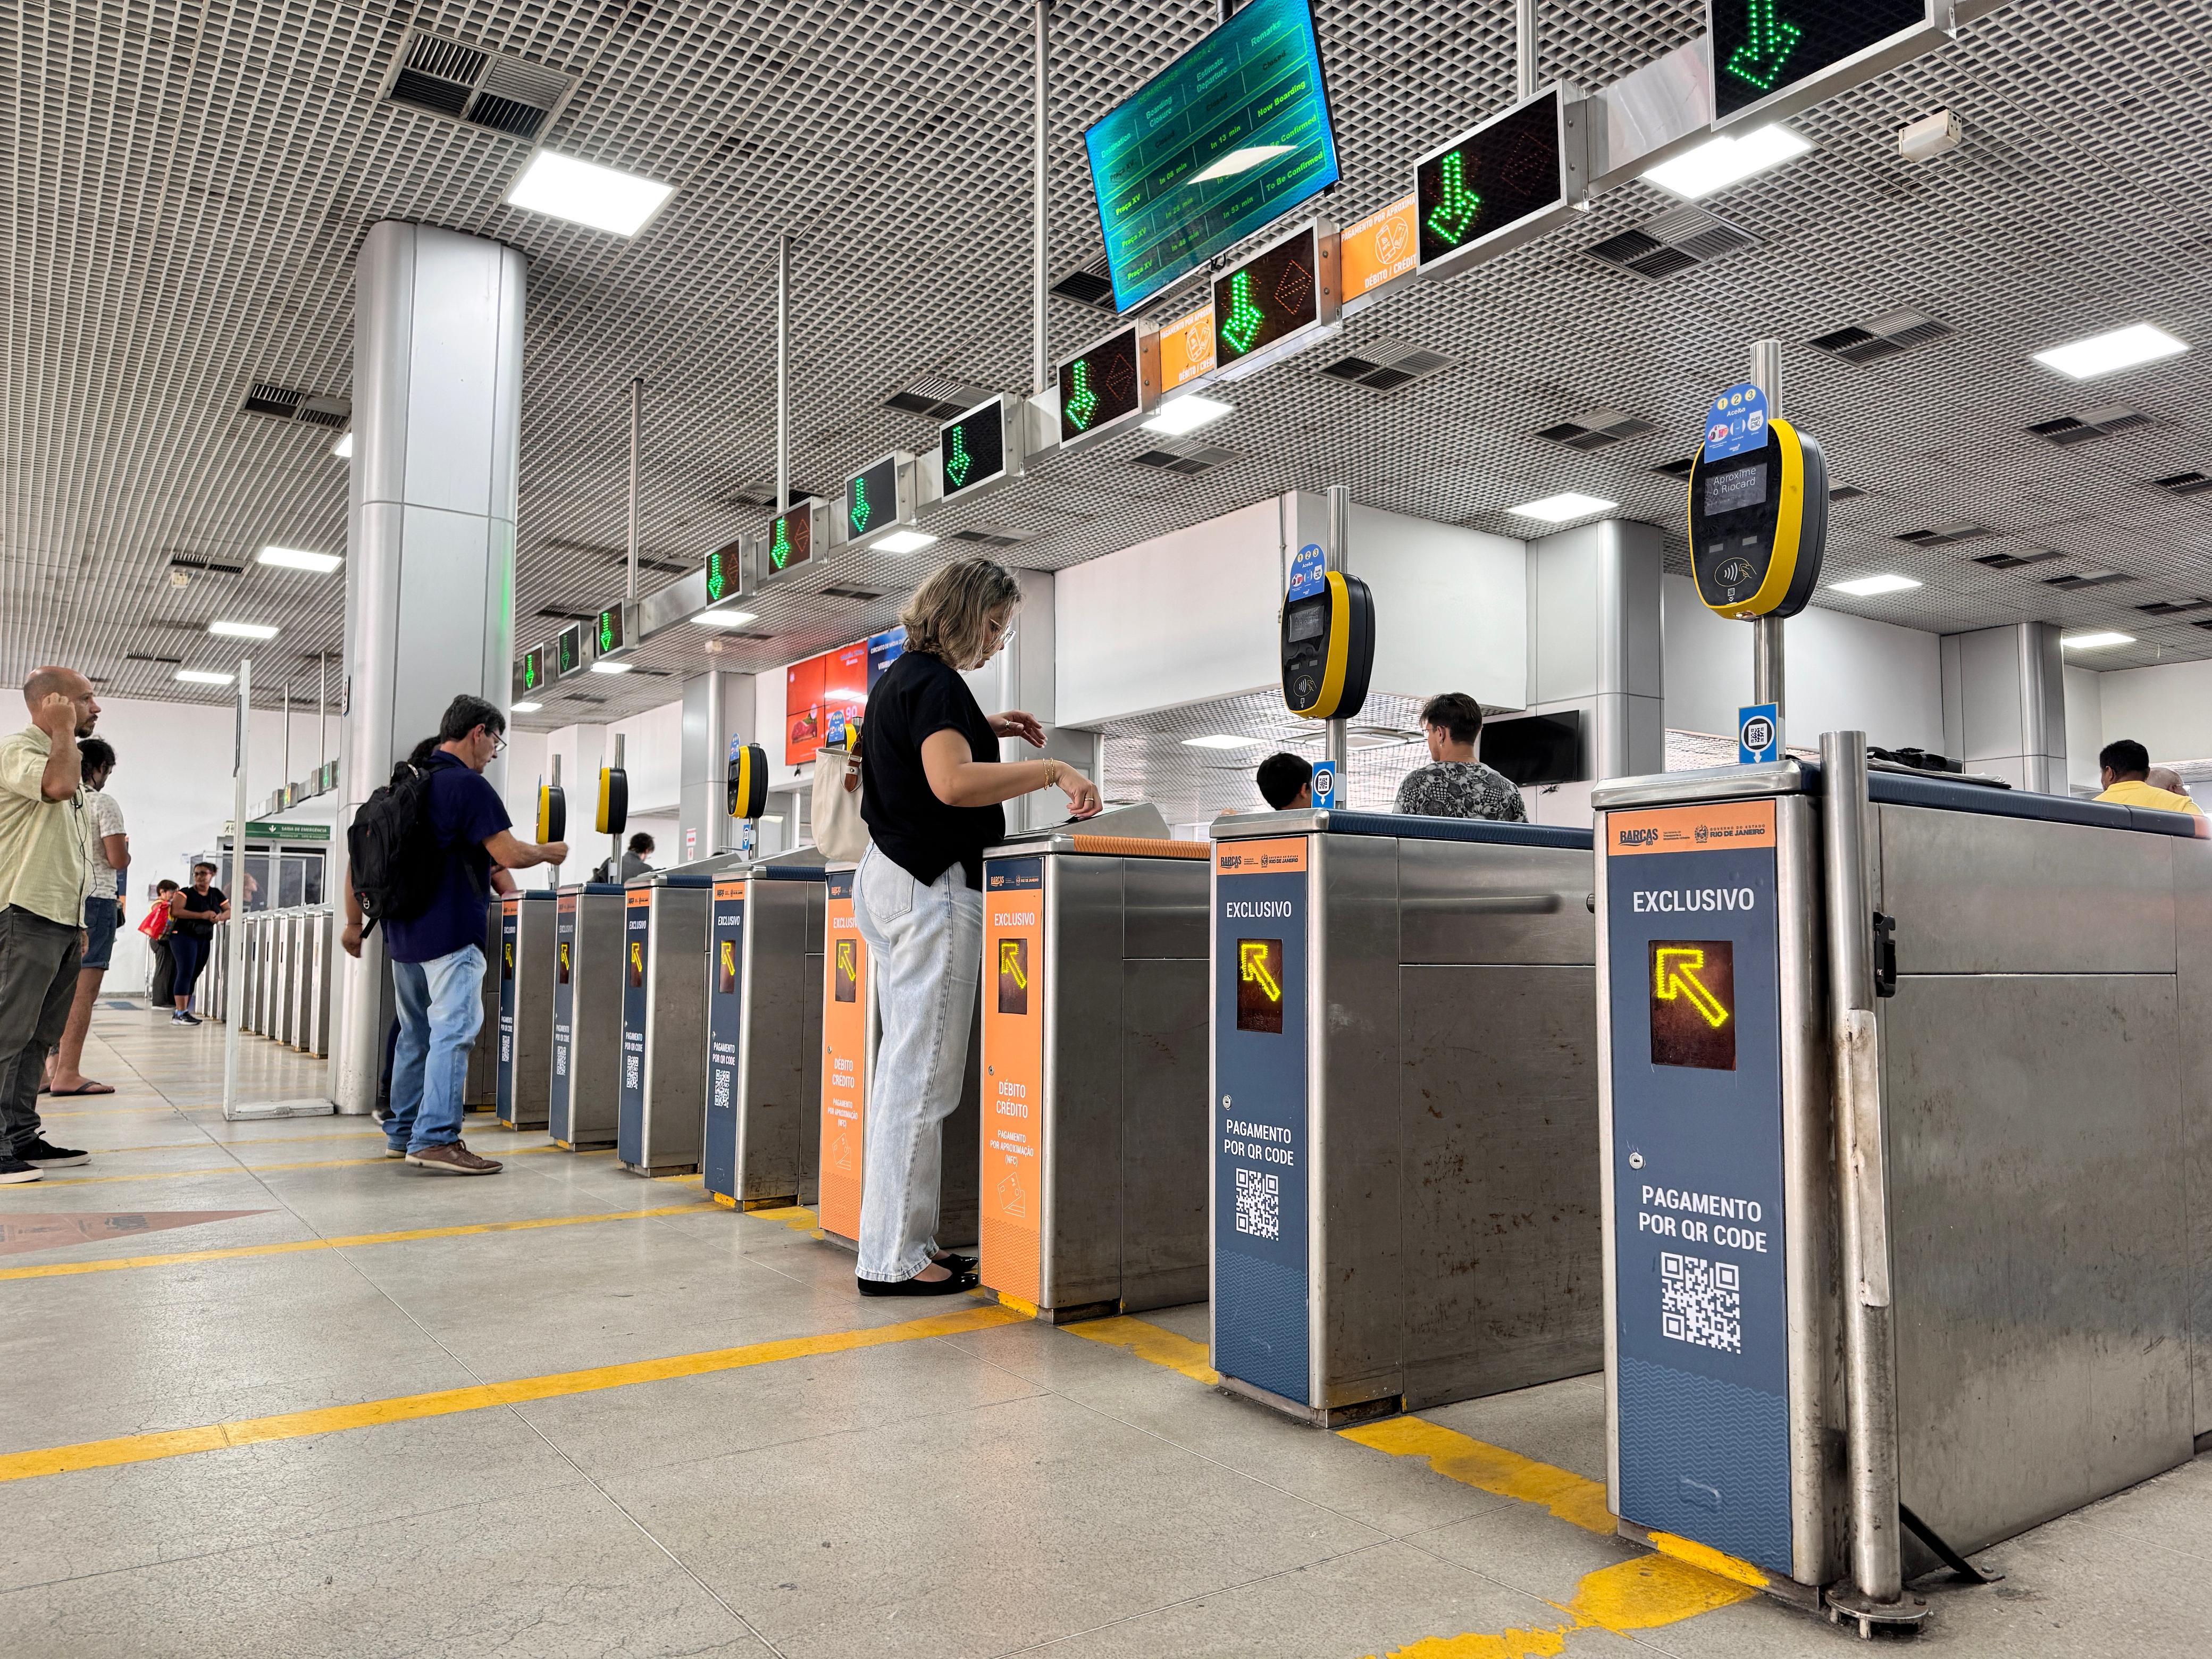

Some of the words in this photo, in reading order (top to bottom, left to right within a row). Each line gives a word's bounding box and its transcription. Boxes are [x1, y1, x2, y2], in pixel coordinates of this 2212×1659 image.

[1251, 20, 1281, 47] Remarks
[1197, 57, 1224, 81] Estimate
[1262, 50, 1286, 71] Closed
[1197, 66, 1227, 93] Departure
[1146, 96, 1172, 119] Boarding
[1205, 92, 1228, 112] Closed
[1256, 101, 1273, 118] Now
[1274, 80, 1306, 106] Boarding
[1150, 107, 1172, 128] Closure
[1218, 135, 1227, 143] 13
[1229, 125, 1241, 137] min
[1281, 114, 1317, 143] Confirmed
[1101, 133, 1132, 158] Destination
[1176, 162, 1187, 173] min
[1266, 182, 1275, 191] To
[1276, 175, 1286, 186] Be
[1287, 150, 1323, 179] Confirmed
[1116, 202, 1132, 216] Praça
[1132, 193, 1141, 204] XV
[1183, 197, 1193, 208] min
[1231, 204, 1239, 213] 53
[1242, 196, 1253, 207] min
[1188, 230, 1199, 241] min
[1341, 219, 1373, 242] PAGAMENTO
[1374, 212, 1386, 225] POR
[1121, 234, 1137, 248] Praça
[1137, 227, 1146, 238] XV
[1127, 266, 1143, 280] Praça
[1143, 258, 1152, 270] XV
[1364, 269, 1387, 289] DÉBITO
[1160, 321, 1185, 341] PAGAMENTO
[1185, 316, 1194, 328] POR
[1179, 365, 1196, 382] DÉBITO
[1727, 407, 1746, 417] Aceita
[1713, 467, 1756, 485] Aproxime
[1721, 476, 1756, 493] Riocard
[1620, 828, 1658, 842] BARCAS
[1221, 856, 1242, 866] BARCAS
[1226, 901, 1292, 918] EXCLUSIVO
[1633, 887, 1755, 913] EXCLUSIVO
[629, 920, 647, 930] EXCLUSIVO
[718, 915, 741, 926] EXCLUSIVO
[833, 917, 858, 928] EXCLUSIV
[994, 912, 1035, 926] EXCLUSIVO
[713, 1042, 735, 1054] PAGAMENTO
[725, 1055, 735, 1066] CODE
[834, 1055, 853, 1072] DÉBITO
[832, 1072, 854, 1088] CRÉDITO
[999, 1079, 1026, 1099] DÉBITO
[833, 1097, 853, 1109] PAGAMENTO
[996, 1099, 1028, 1119] CRÉDITO
[998, 1129, 1026, 1143] PAGAMENTO
[1226, 1119, 1292, 1144] PAGAMENTO
[990, 1139, 1000, 1150] POR
[1000, 1141, 1034, 1158] APROXIMAÇÃO
[1224, 1139, 1245, 1157] POR
[1247, 1143, 1262, 1160] QR
[1265, 1146, 1294, 1166] CODE
[1005, 1155, 1018, 1167] (NFC)
[1642, 1185, 1762, 1222] PAGAMENTO
[1639, 1212, 1676, 1237] POR
[1681, 1219, 1708, 1243] QR
[1714, 1225, 1767, 1253] CODE
